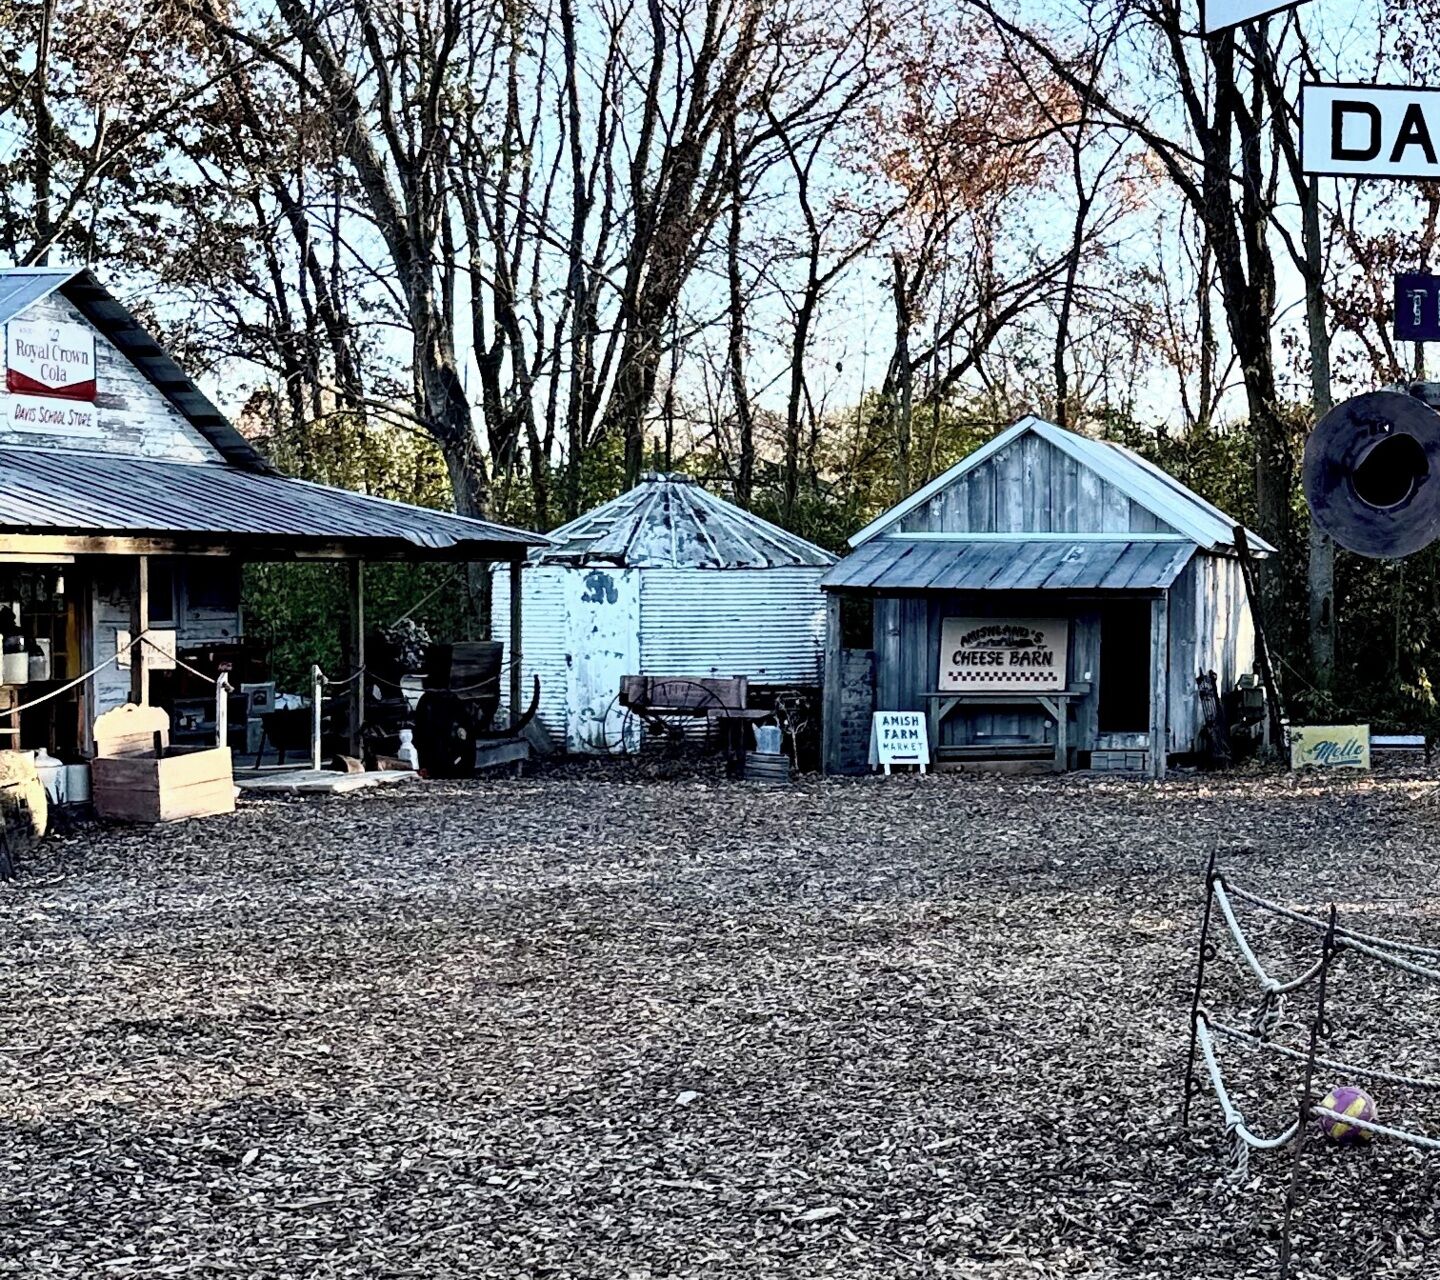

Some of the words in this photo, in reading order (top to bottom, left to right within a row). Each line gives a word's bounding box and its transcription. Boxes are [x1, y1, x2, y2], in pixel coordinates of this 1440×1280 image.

[15, 338, 49, 363] Royal
[52, 344, 89, 365] Crown
[40, 363, 67, 382] Cola
[952, 650, 1005, 667] CHEESE
[1009, 651, 1054, 667] BARN
[882, 715, 919, 726] AMISH
[884, 729, 919, 740] FARM
[1312, 736, 1365, 766] Mello
